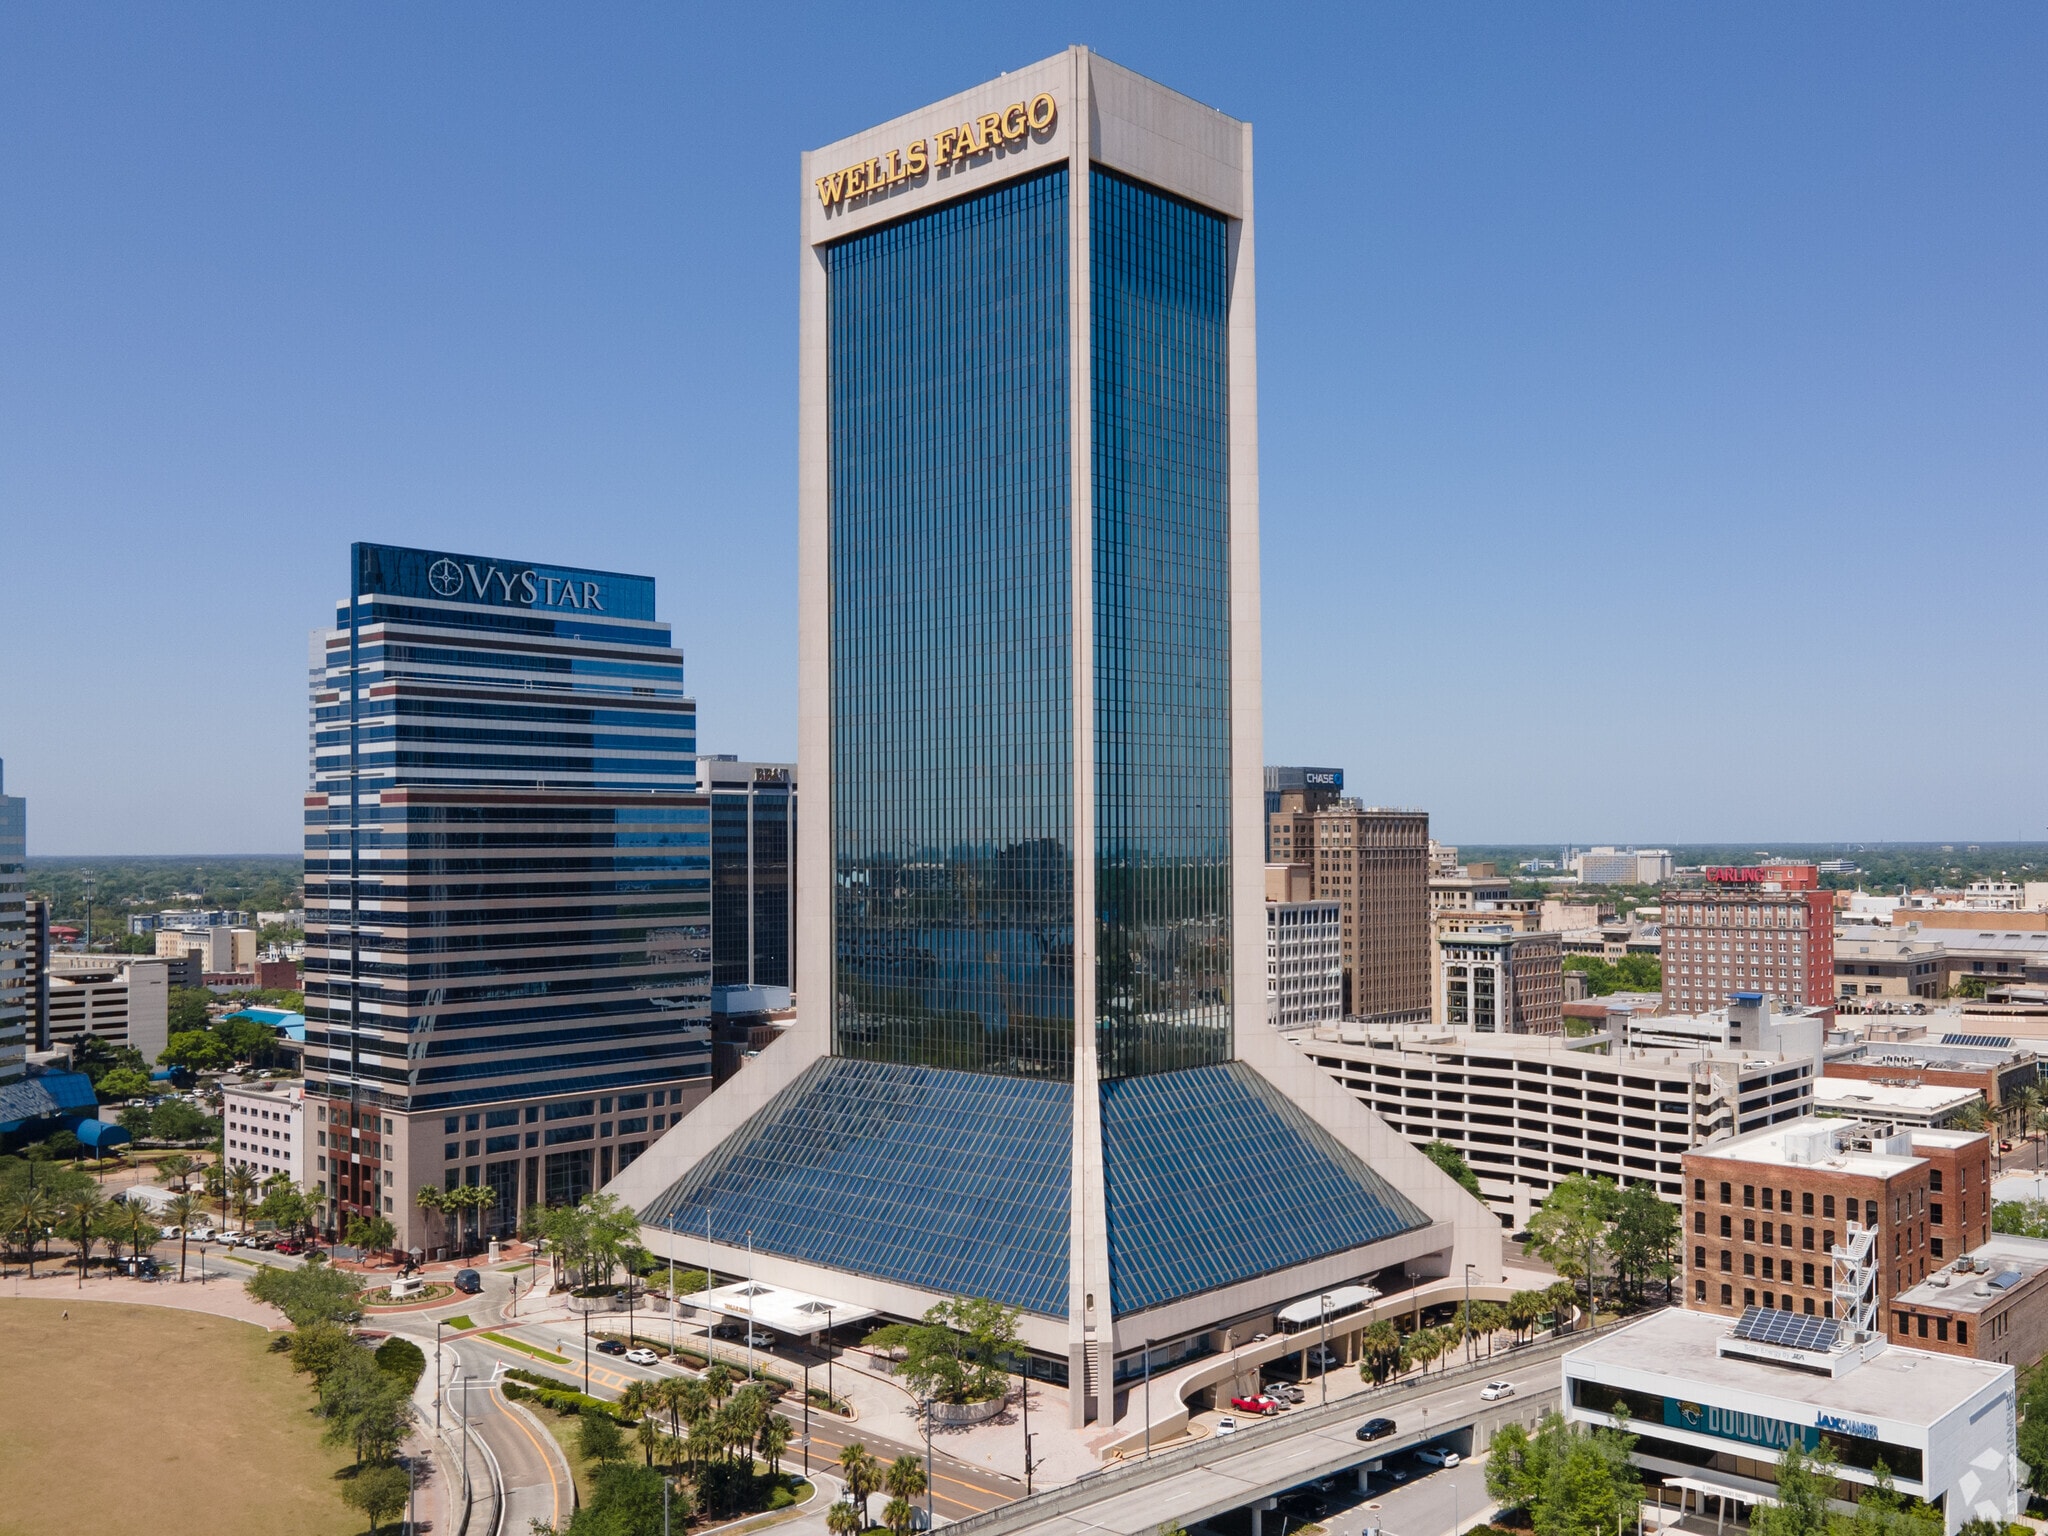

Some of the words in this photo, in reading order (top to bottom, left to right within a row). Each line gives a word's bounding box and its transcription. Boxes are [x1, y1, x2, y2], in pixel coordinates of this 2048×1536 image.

[815, 139, 928, 207] WELLS
[933, 92, 1056, 167] FARGO
[754, 767, 789, 782] BB&T
[1306, 773, 1334, 783] CHASE
[1706, 867, 1764, 882] CARLING
